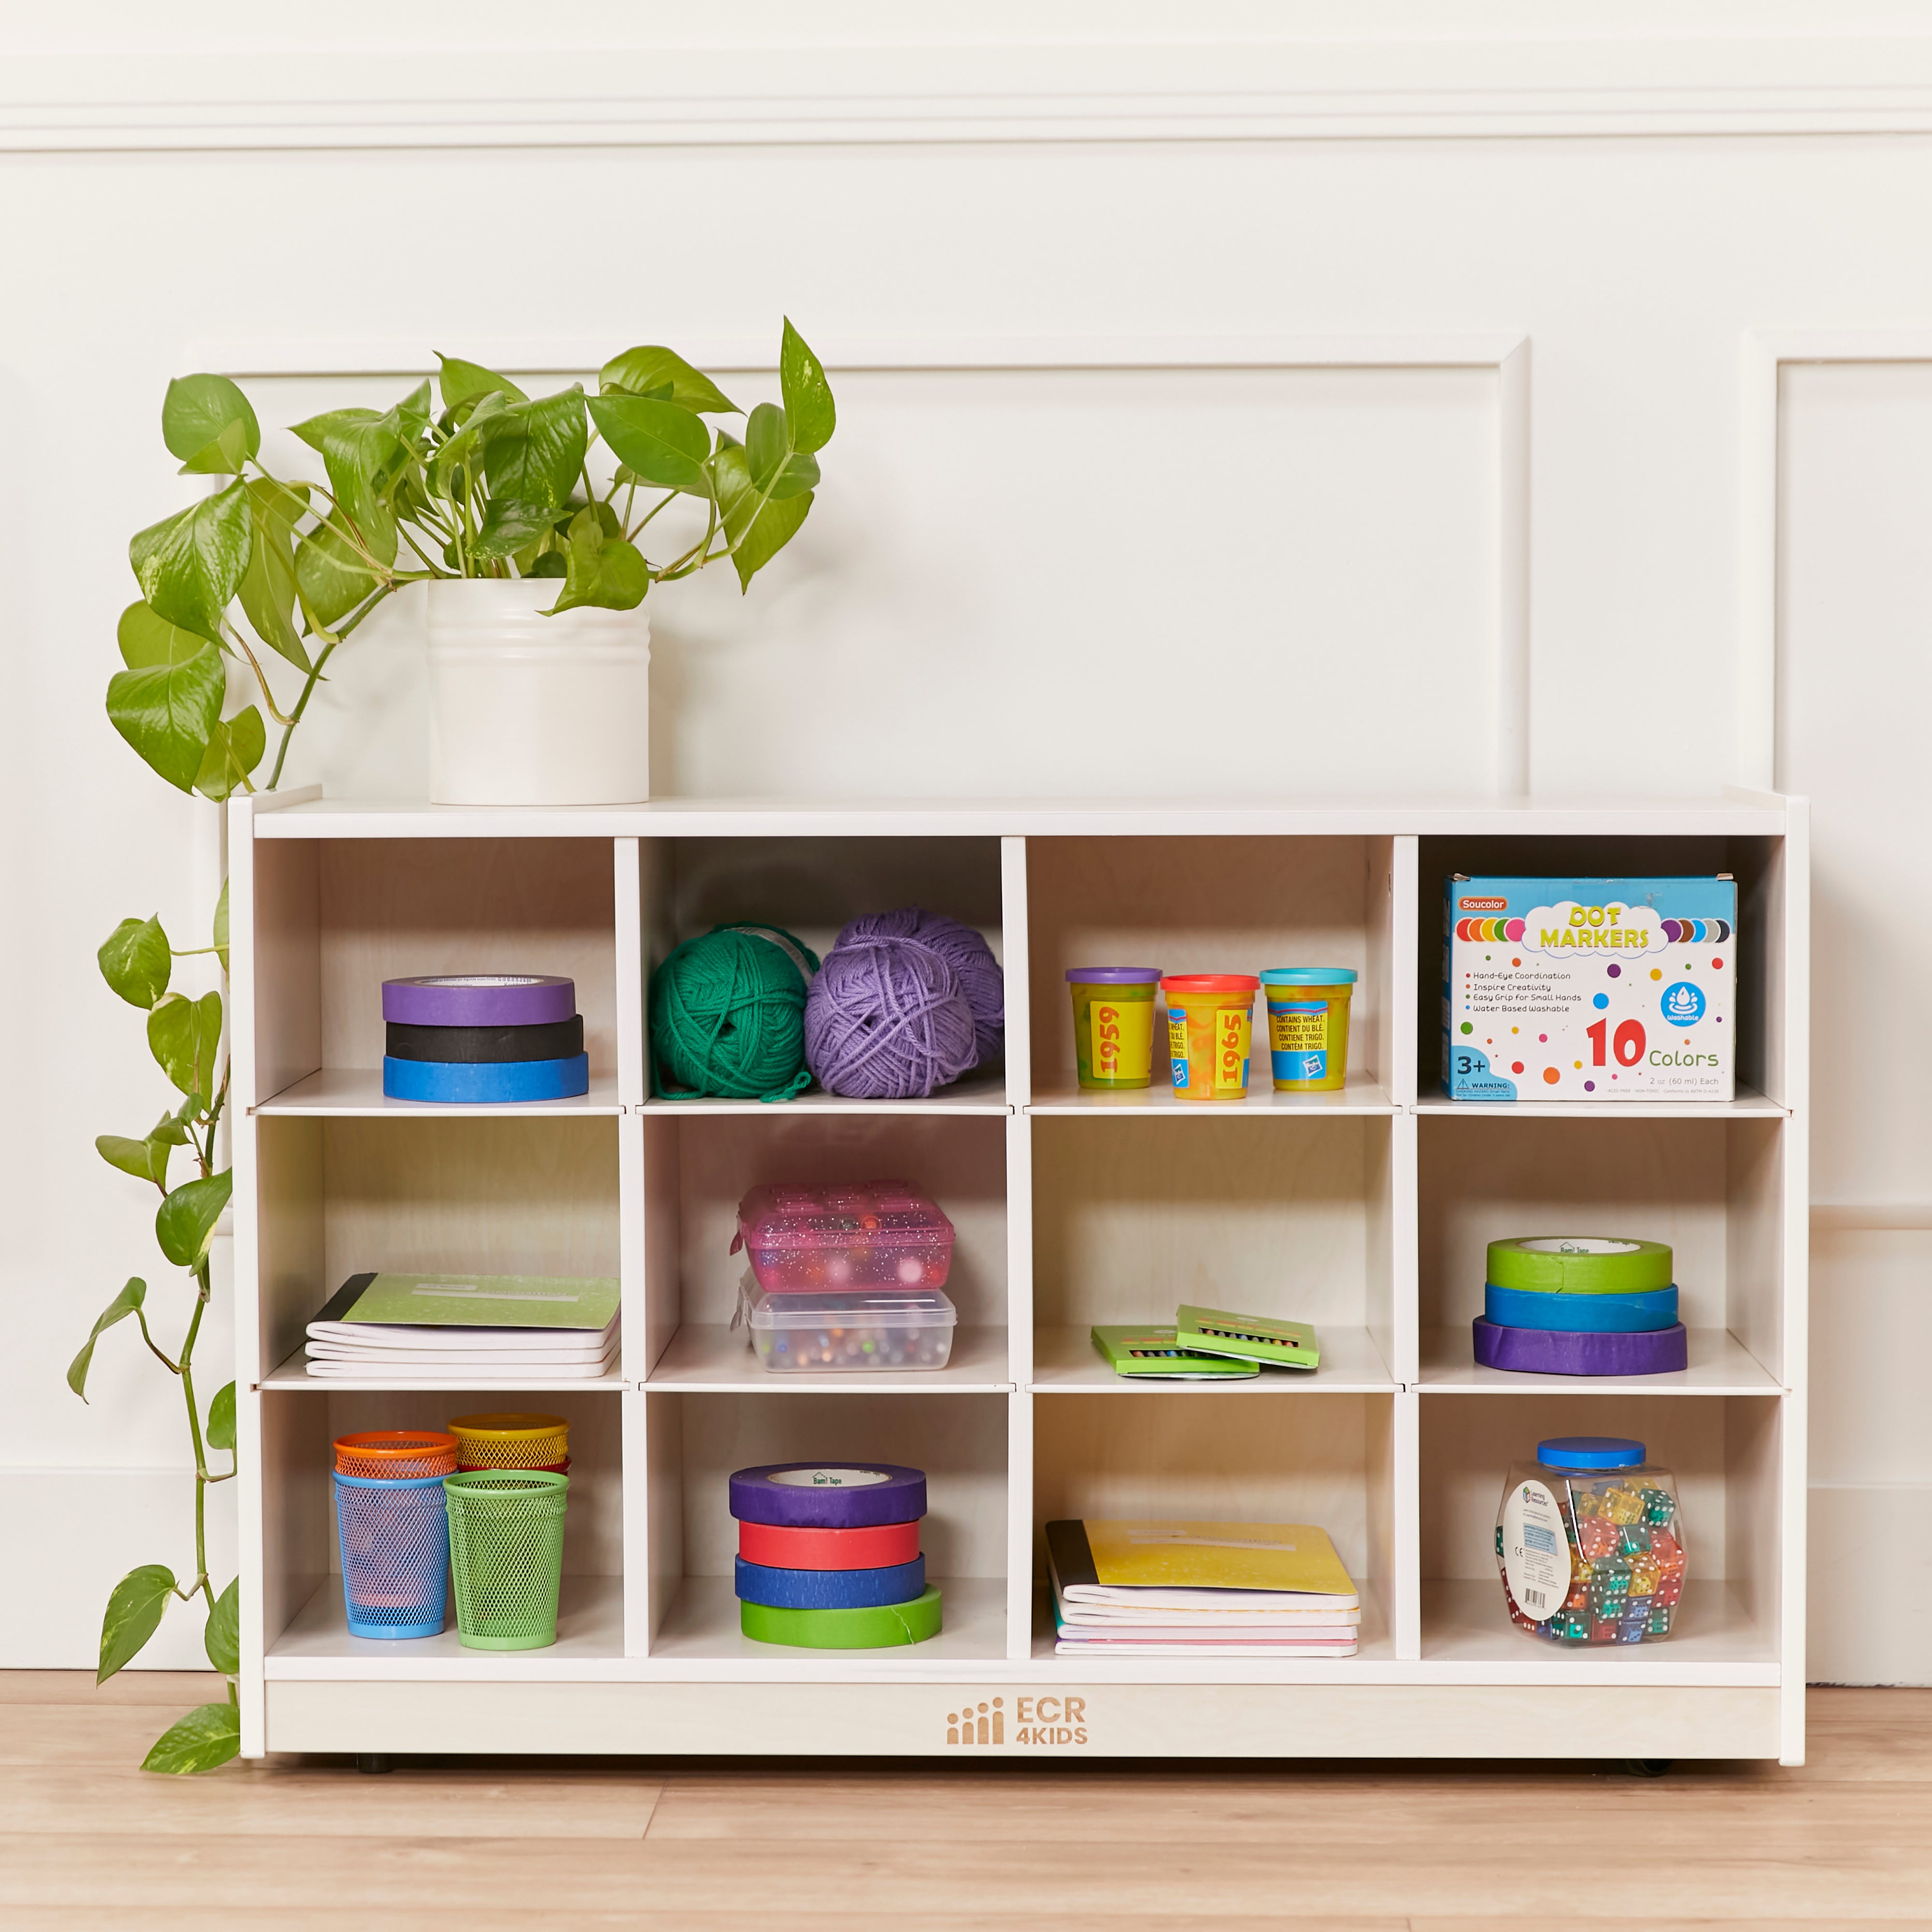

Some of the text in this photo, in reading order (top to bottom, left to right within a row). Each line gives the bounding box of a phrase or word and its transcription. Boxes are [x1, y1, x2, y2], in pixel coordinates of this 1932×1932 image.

[1463, 900, 1504, 909] Soucolor
[1569, 906, 1621, 927] DOT
[1540, 928, 1649, 948] MARKERS
[1312, 1023, 1324, 1031] BLÉ.
[1099, 1006, 1120, 1073] 1959
[1222, 1014, 1241, 1082] 1965
[1586, 1017, 1646, 1067] 10
[1457, 1056, 1485, 1074] 3+
[1649, 1050, 1719, 1066] Colors
[829, 1477, 841, 1486] Tape
[1017, 1697, 1086, 1723] ECR
[1016, 1727, 1087, 1745] 4KIDS
